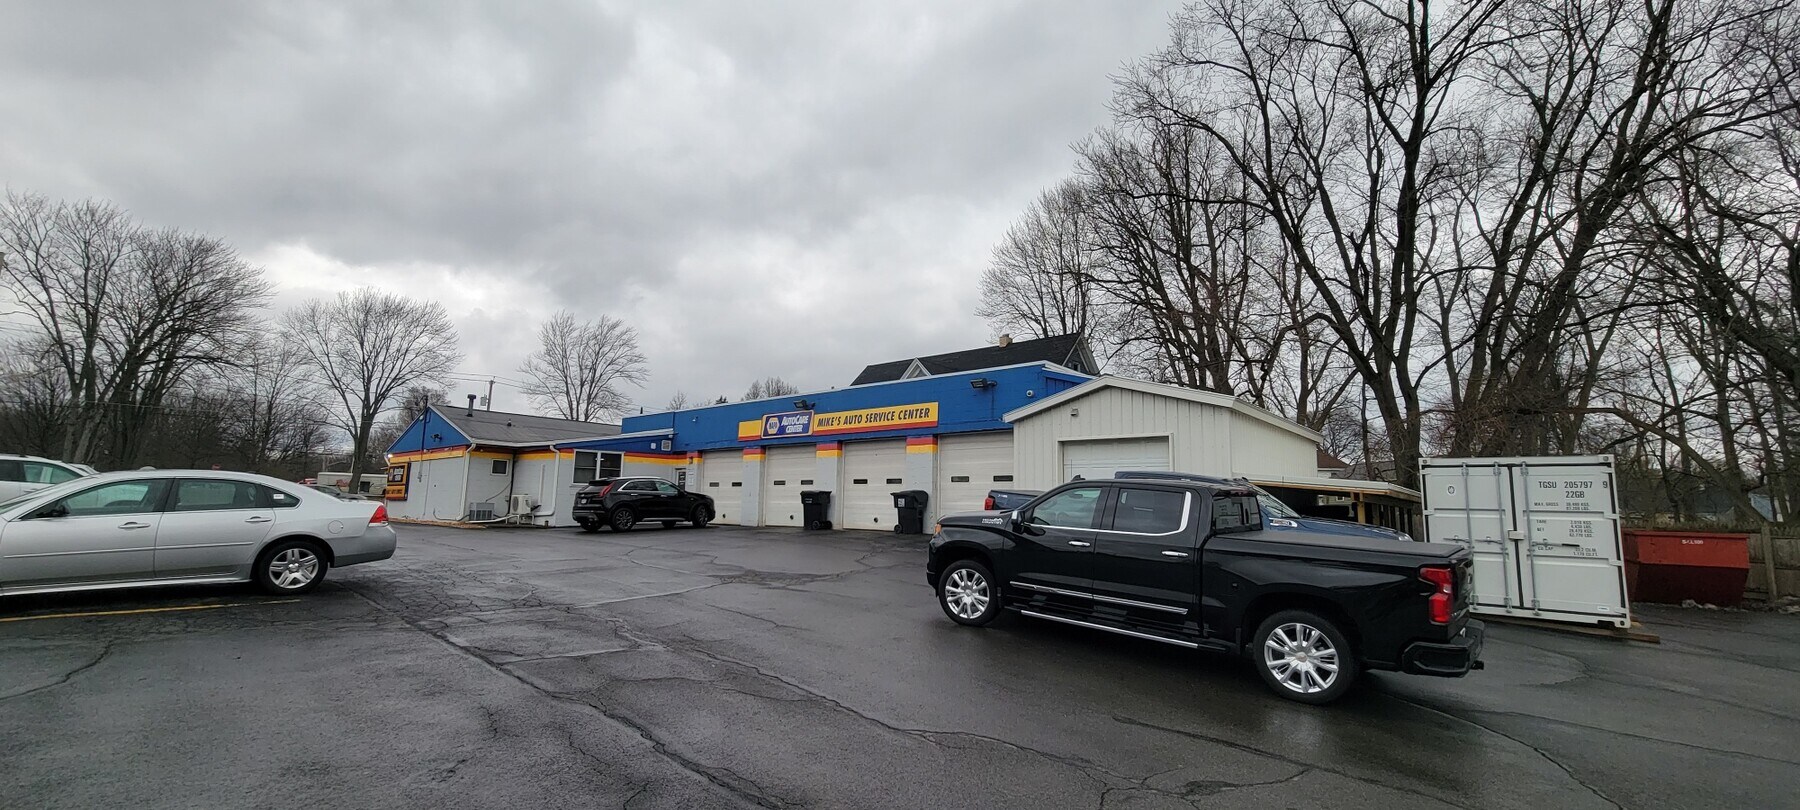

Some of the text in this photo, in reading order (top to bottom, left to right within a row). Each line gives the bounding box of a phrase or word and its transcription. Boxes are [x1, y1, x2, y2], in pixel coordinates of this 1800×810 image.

[817, 408, 930, 428] MIKE'S AUTO SERVICE CENTER
[785, 425, 803, 433] CENTER
[1538, 481, 1608, 489] TGSU 205797 9
